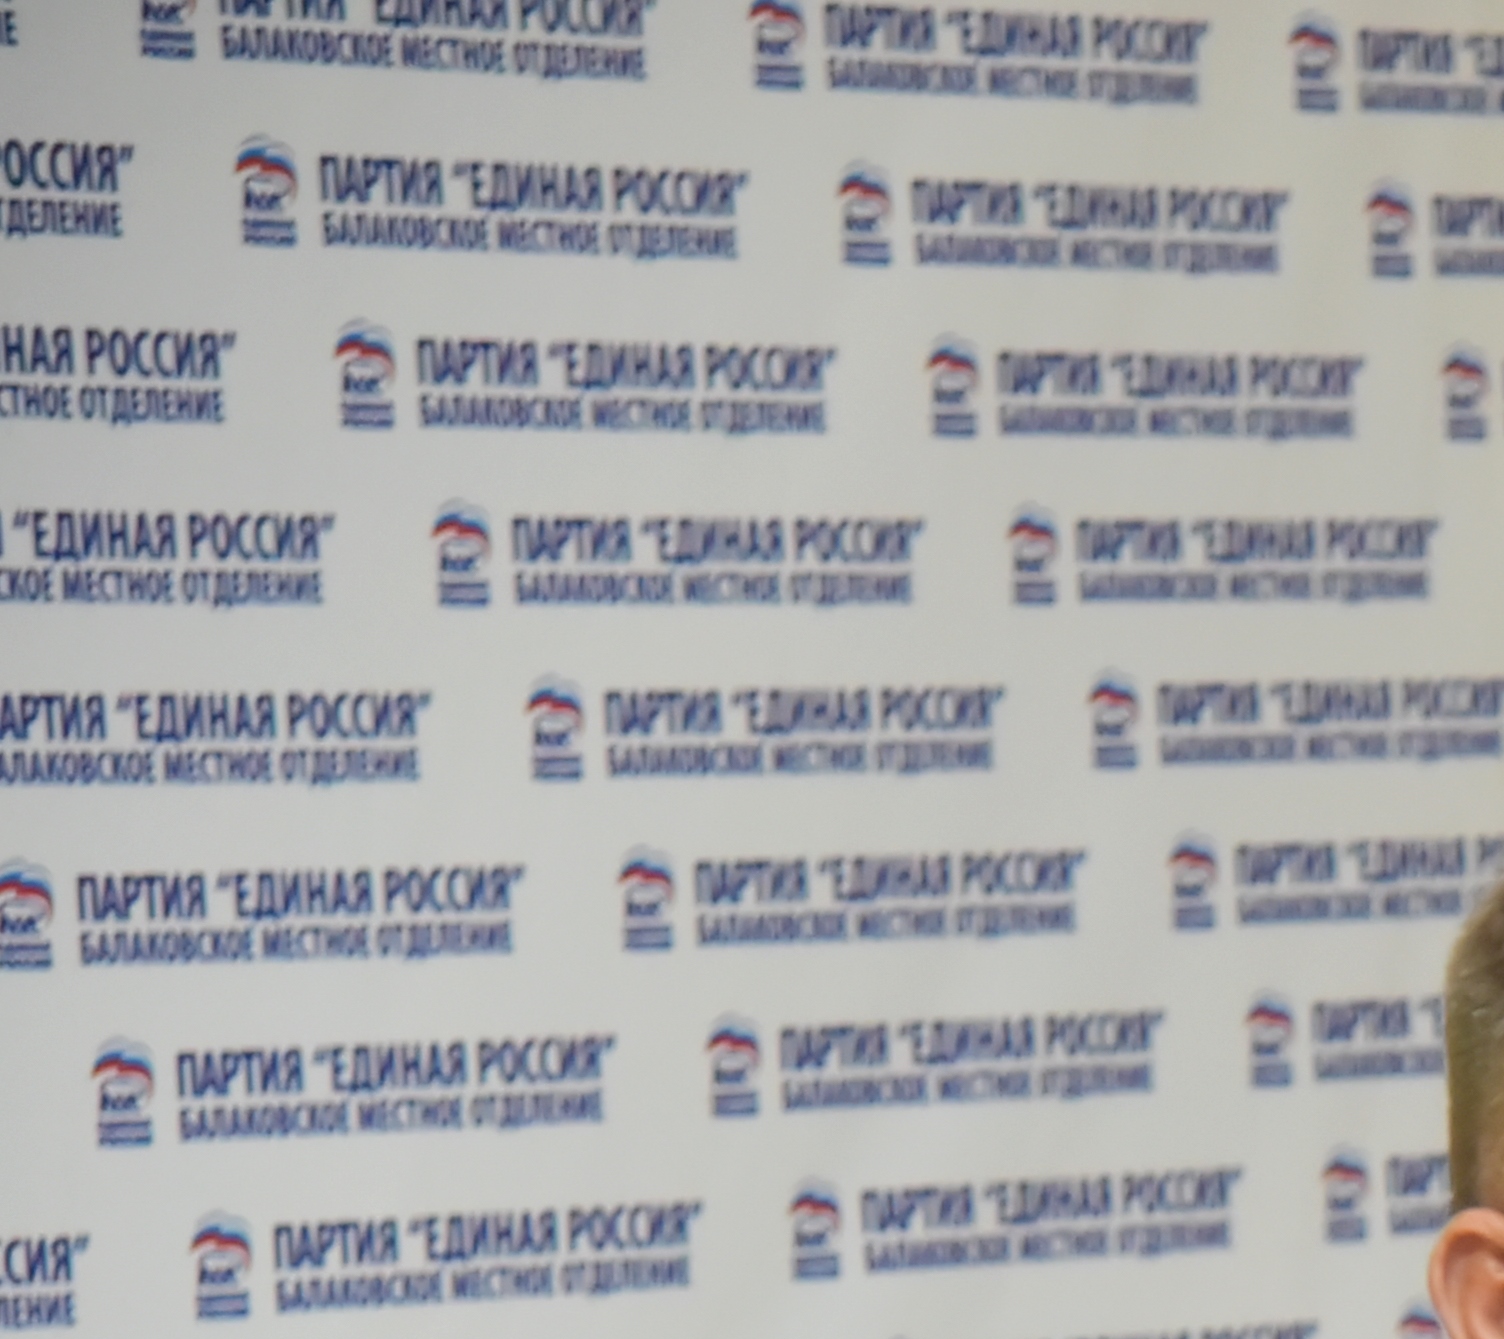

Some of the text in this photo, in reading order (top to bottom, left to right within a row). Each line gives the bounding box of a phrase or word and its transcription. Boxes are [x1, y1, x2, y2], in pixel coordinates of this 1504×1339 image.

[222, 24, 395, 67] БАЛАКОВСКОЕ
[401, 34, 506, 73] МЕСТНОЕ
[0, 138, 135, 194] ОССИЯ”
[318, 154, 445, 206] ПАРТИЯ
[0, 197, 124, 240] ДЕЛЕНИЕ
[416, 337, 539, 387] ПАРТИЯ
[0, 384, 226, 427] СТНОЕ ОТДЕЛЕНИЕ
[511, 516, 632, 564] ПАРТИЯ
[62, 569, 174, 606] МЕСТНОЕ
[182, 569, 322, 610] ОТДЕЛЕНИЕ
[0, 690, 109, 742] АРТИЯ
[0, 747, 421, 789] АЛАКОВСКОЕ МЕСТНОЕ ОТДЕЛЕНИЕ
[76, 873, 208, 923] ПАРТИЯ
[81, 919, 509, 968] БАЛАКОВСКОЕ МЕСТНОЕ ОТДЕЛЕНИЕ
[176, 1047, 305, 1099] ПАРТИЯ
[179, 1088, 601, 1142] БАЛАКОВСКОЕ МЕСТНОЕ ОТДЕЛЕНИЕ
[273, 1218, 400, 1271] ПАРТИЯ
[276, 1256, 689, 1314] БАЛАКОВСКОЕ МЕСТНОЕ ОТДЕЛЕНИЕ
